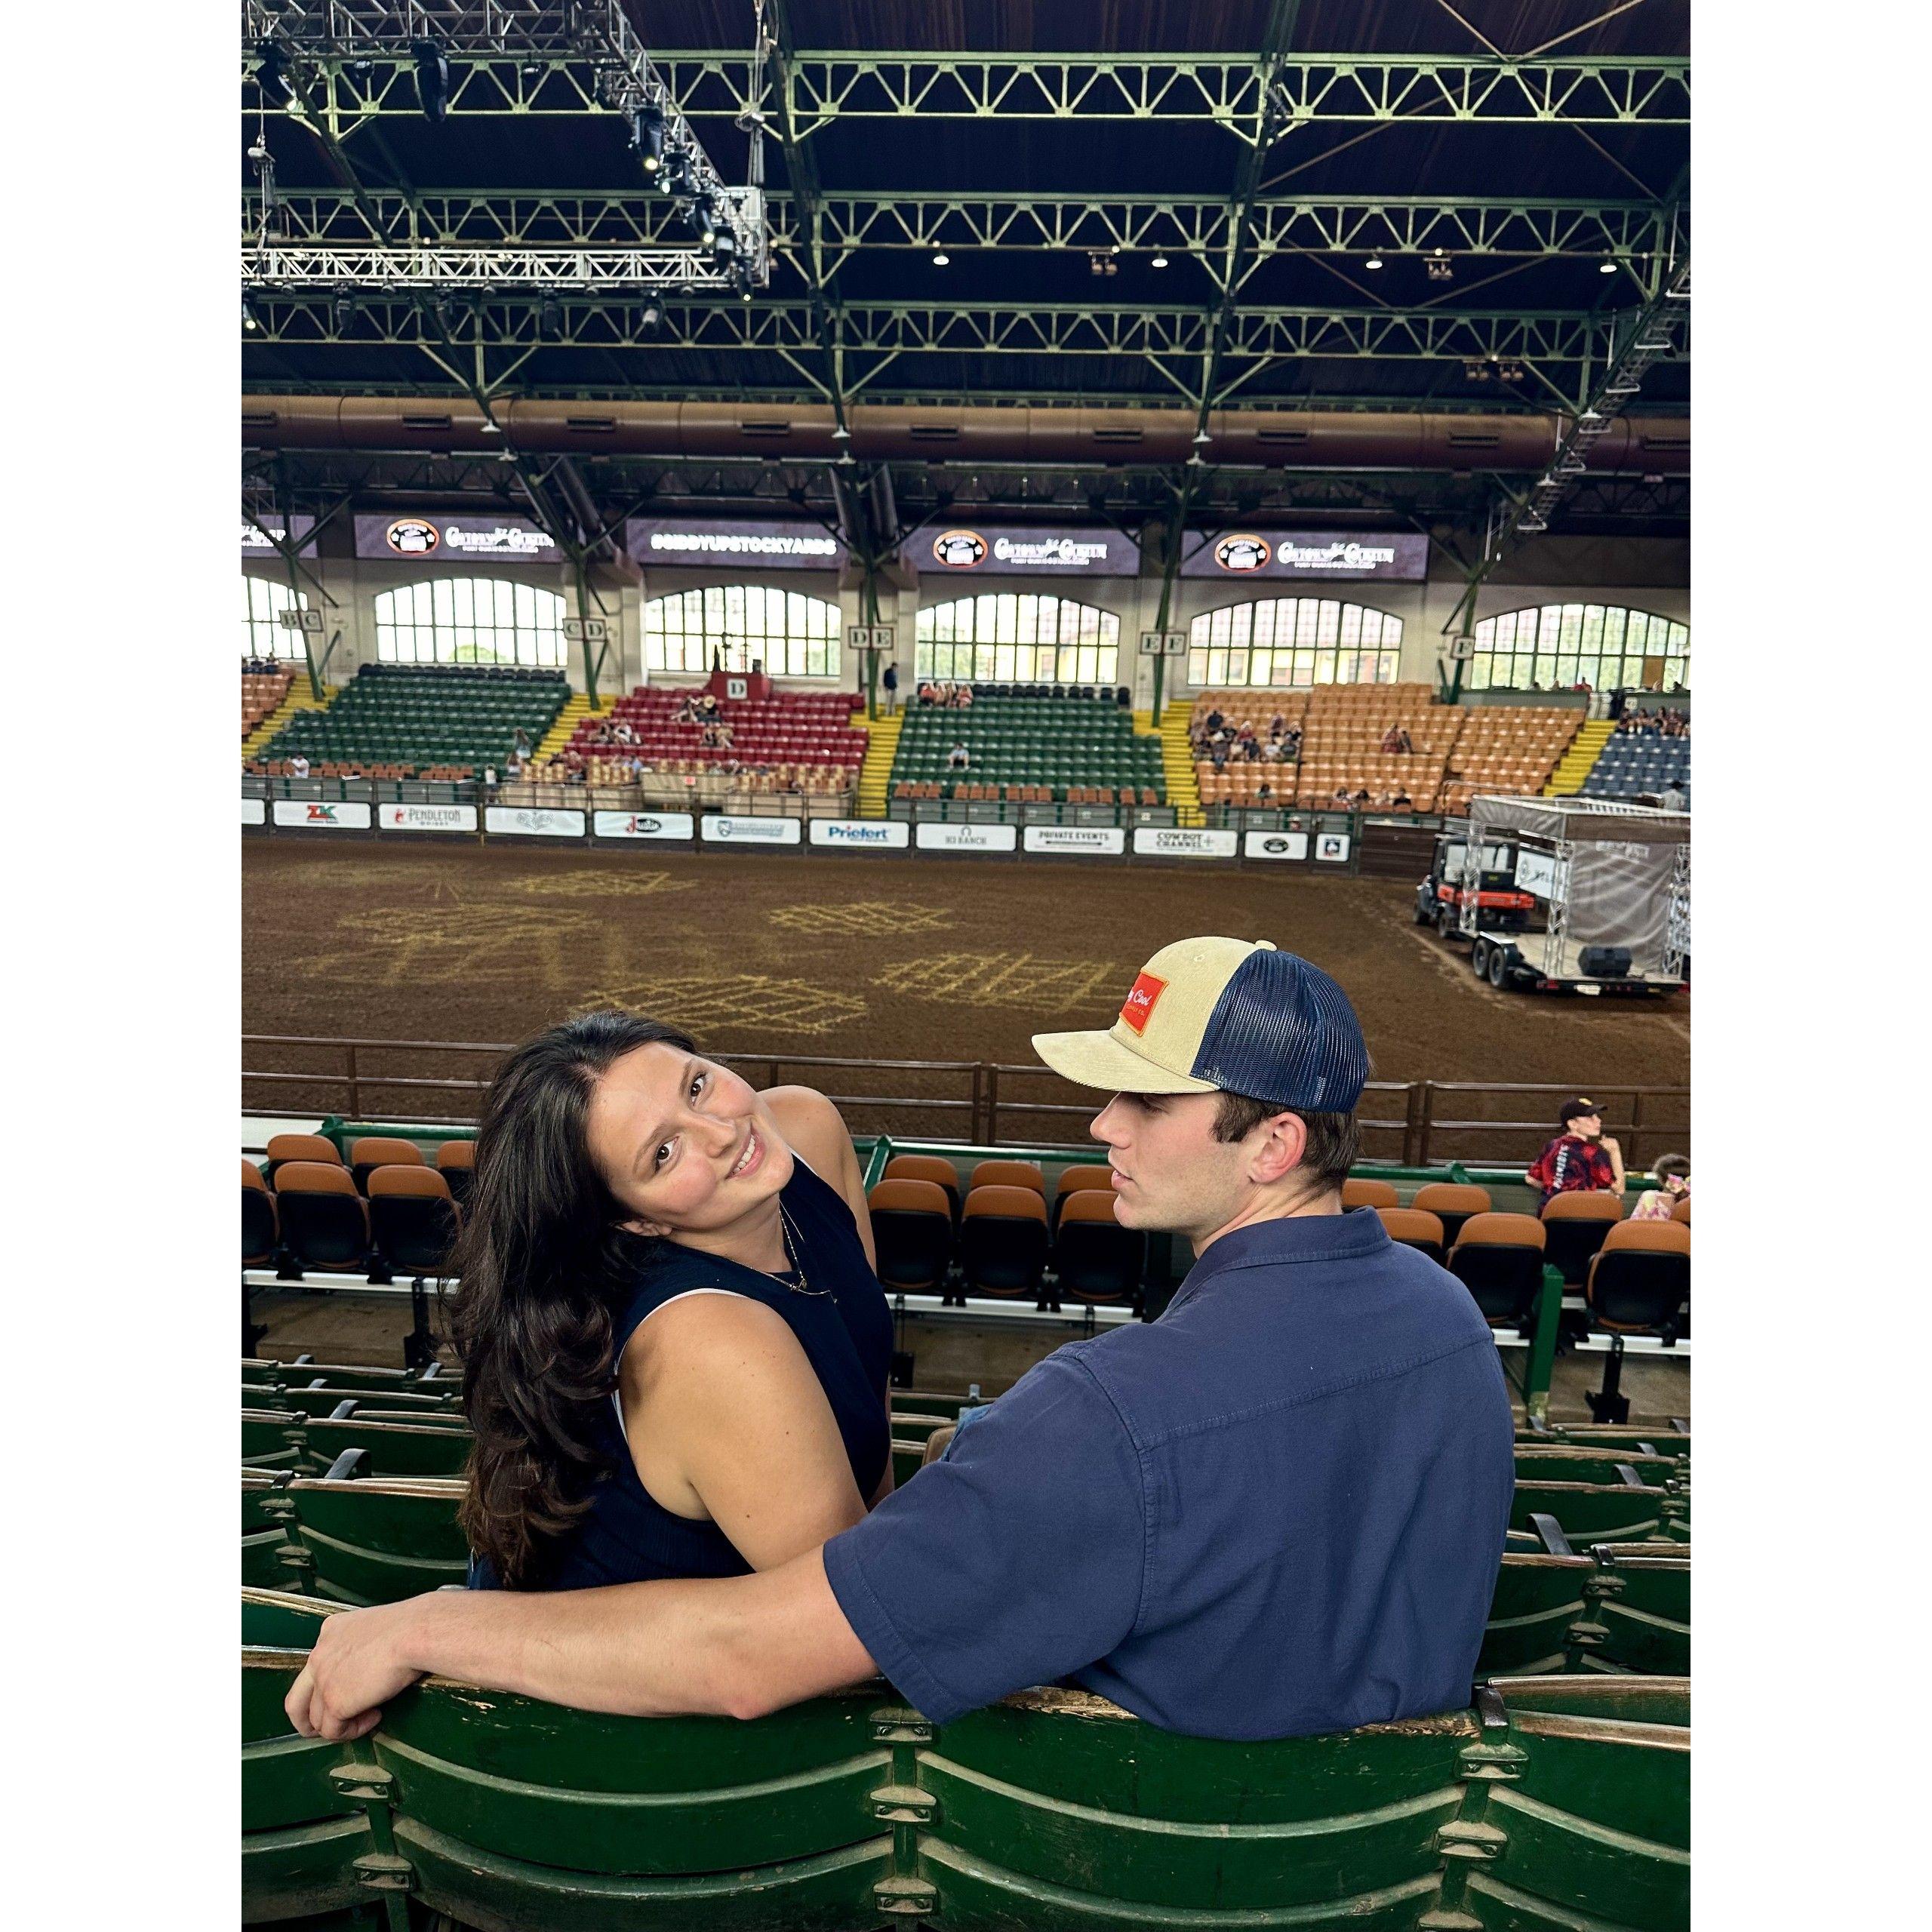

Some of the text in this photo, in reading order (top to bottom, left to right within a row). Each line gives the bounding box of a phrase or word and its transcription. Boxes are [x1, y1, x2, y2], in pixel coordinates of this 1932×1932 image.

[305, 614, 317, 626] C
[567, 623, 602, 635] C D
[854, 631, 889, 645] D E
[1146, 636, 1183, 649] E F
[1458, 641, 1471, 654] F
[731, 681, 744, 694] D
[409, 808, 460, 823] PENDLETON
[1038, 831, 1109, 841] PRIVATE EVENTS
